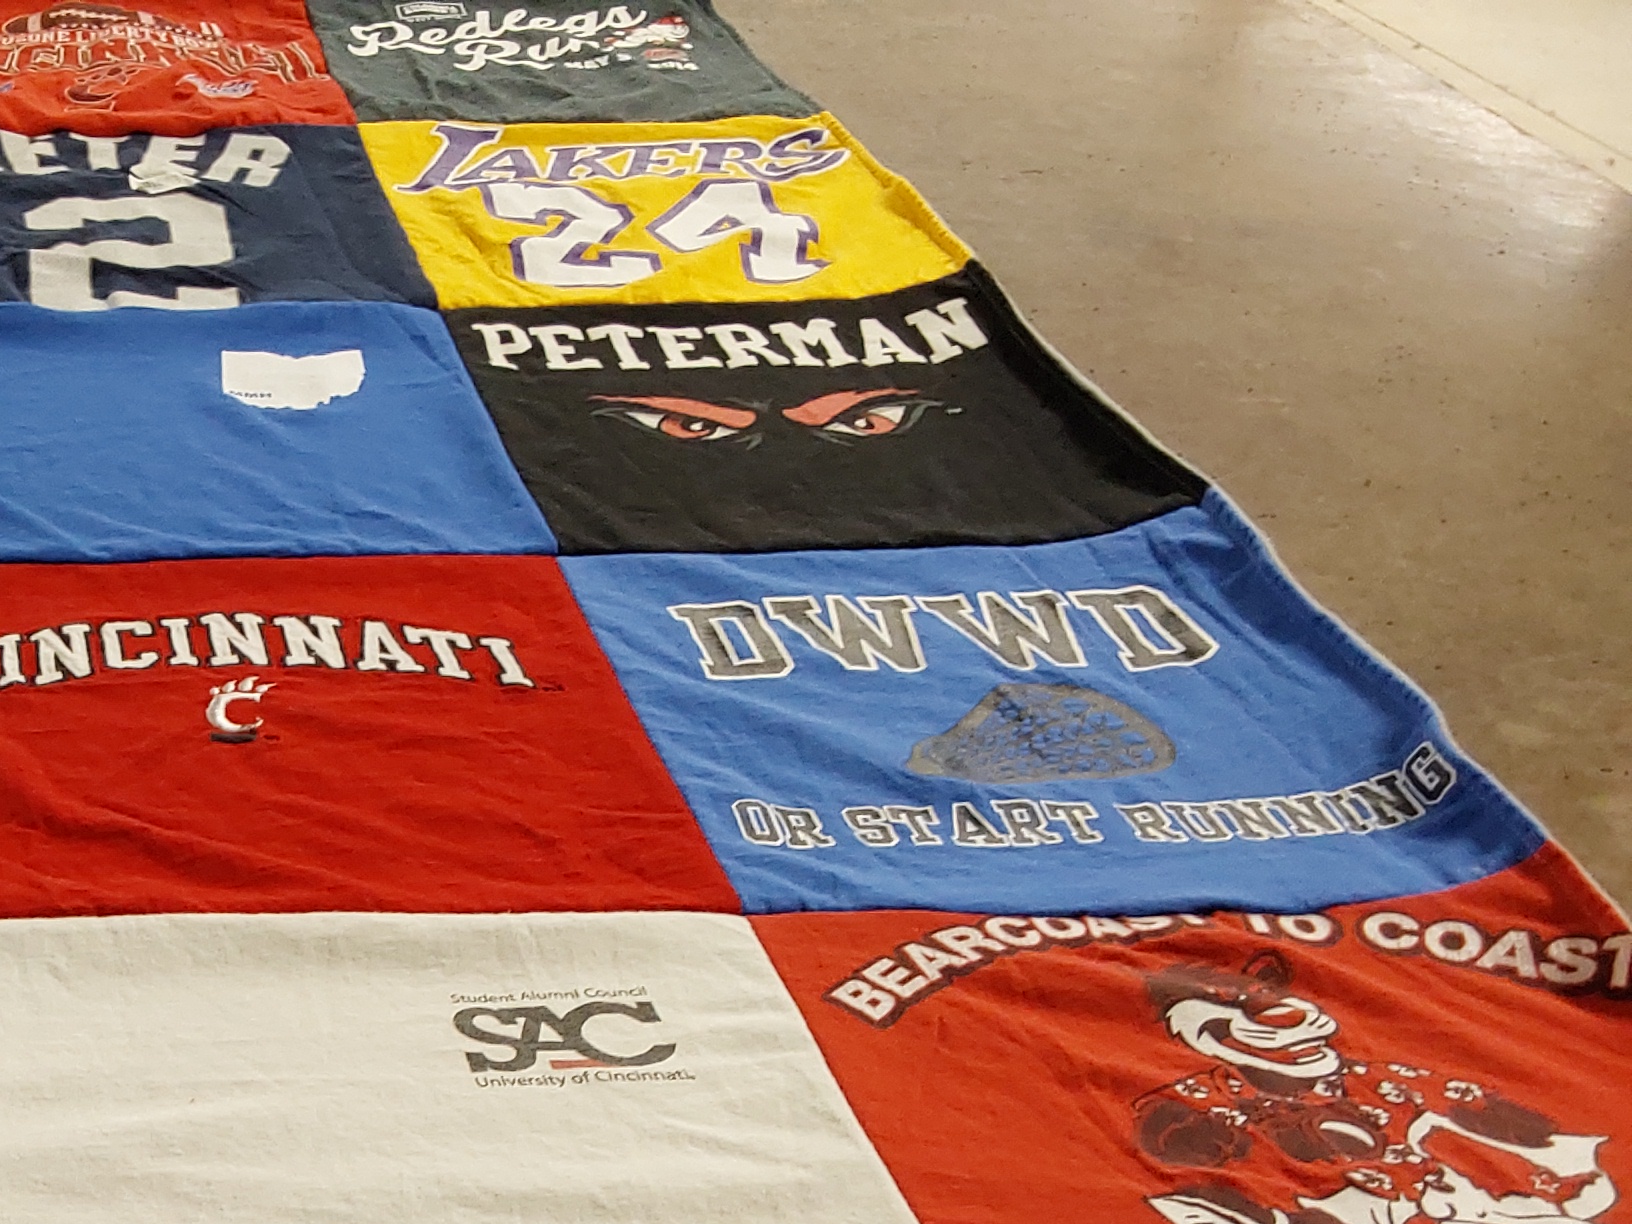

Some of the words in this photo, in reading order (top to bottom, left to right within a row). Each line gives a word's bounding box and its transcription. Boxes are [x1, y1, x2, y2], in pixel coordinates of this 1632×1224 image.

[348, 5, 647, 57] Redlegs
[453, 37, 615, 71] Run
[394, 122, 853, 192] LAKERS
[24, 193, 240, 312] 2
[478, 178, 835, 287] 24
[471, 298, 988, 371] PETERMAN
[667, 585, 1221, 681] DWWD
[732, 797, 834, 849] OR
[843, 797, 1105, 849] START
[1119, 738, 1460, 845] RUNNING
[450, 992, 517, 1004] Student
[521, 988, 580, 1001] Alumni
[584, 985, 648, 998] Council
[453, 1001, 677, 1073] SAC
[475, 1074, 567, 1089] University
[571, 1071, 591, 1084] of
